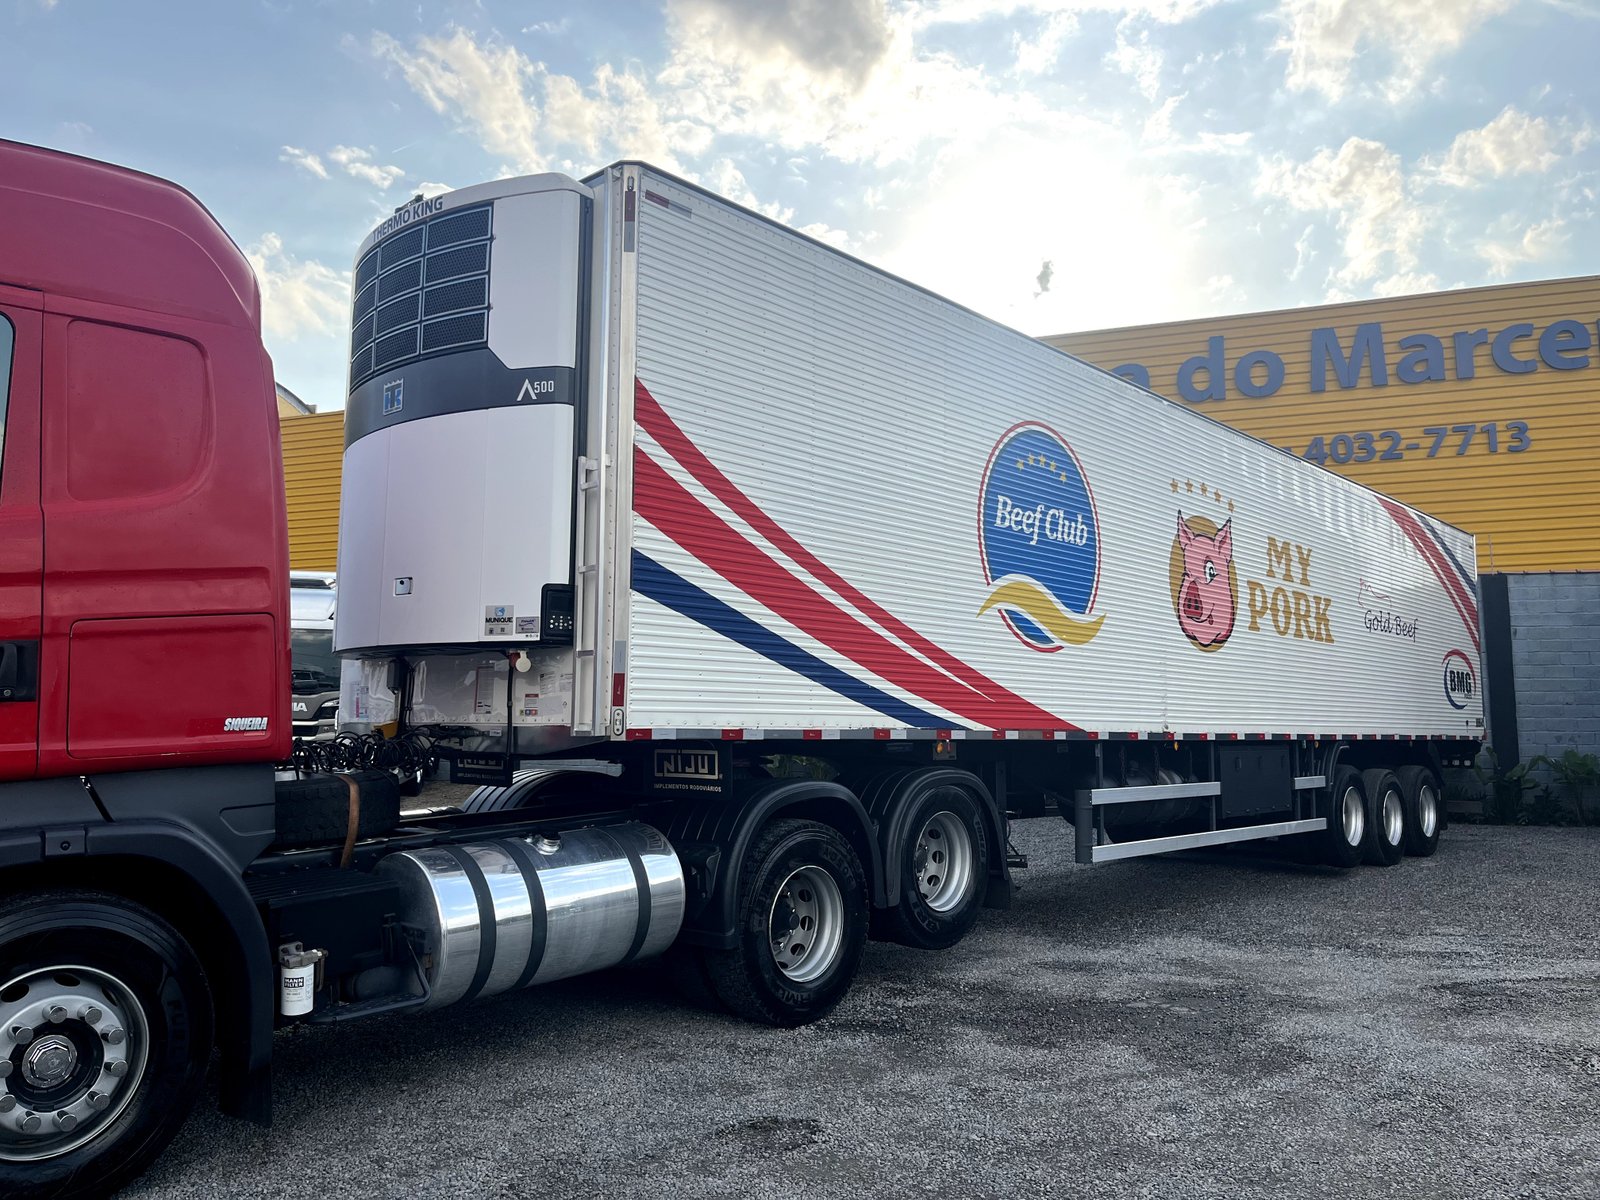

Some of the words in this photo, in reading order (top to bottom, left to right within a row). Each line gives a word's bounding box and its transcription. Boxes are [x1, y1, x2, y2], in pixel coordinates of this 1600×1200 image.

[373, 208, 411, 242] THERMO
[413, 196, 443, 220] KING
[1176, 335, 1286, 402] do
[1310, 318, 1600, 393] Marce
[1302, 421, 1532, 466] 4032-7713
[994, 495, 1045, 545] Beef
[1045, 508, 1088, 546] Club
[1266, 536, 1312, 587] MY
[1247, 580, 1335, 644] PORK
[1364, 610, 1394, 634] Gold
[1395, 615, 1419, 643] Beef
[1449, 670, 1472, 694] BMG
[223, 717, 268, 731] SIQUEIRA
[653, 783, 689, 791] IMPLEMENTOS
